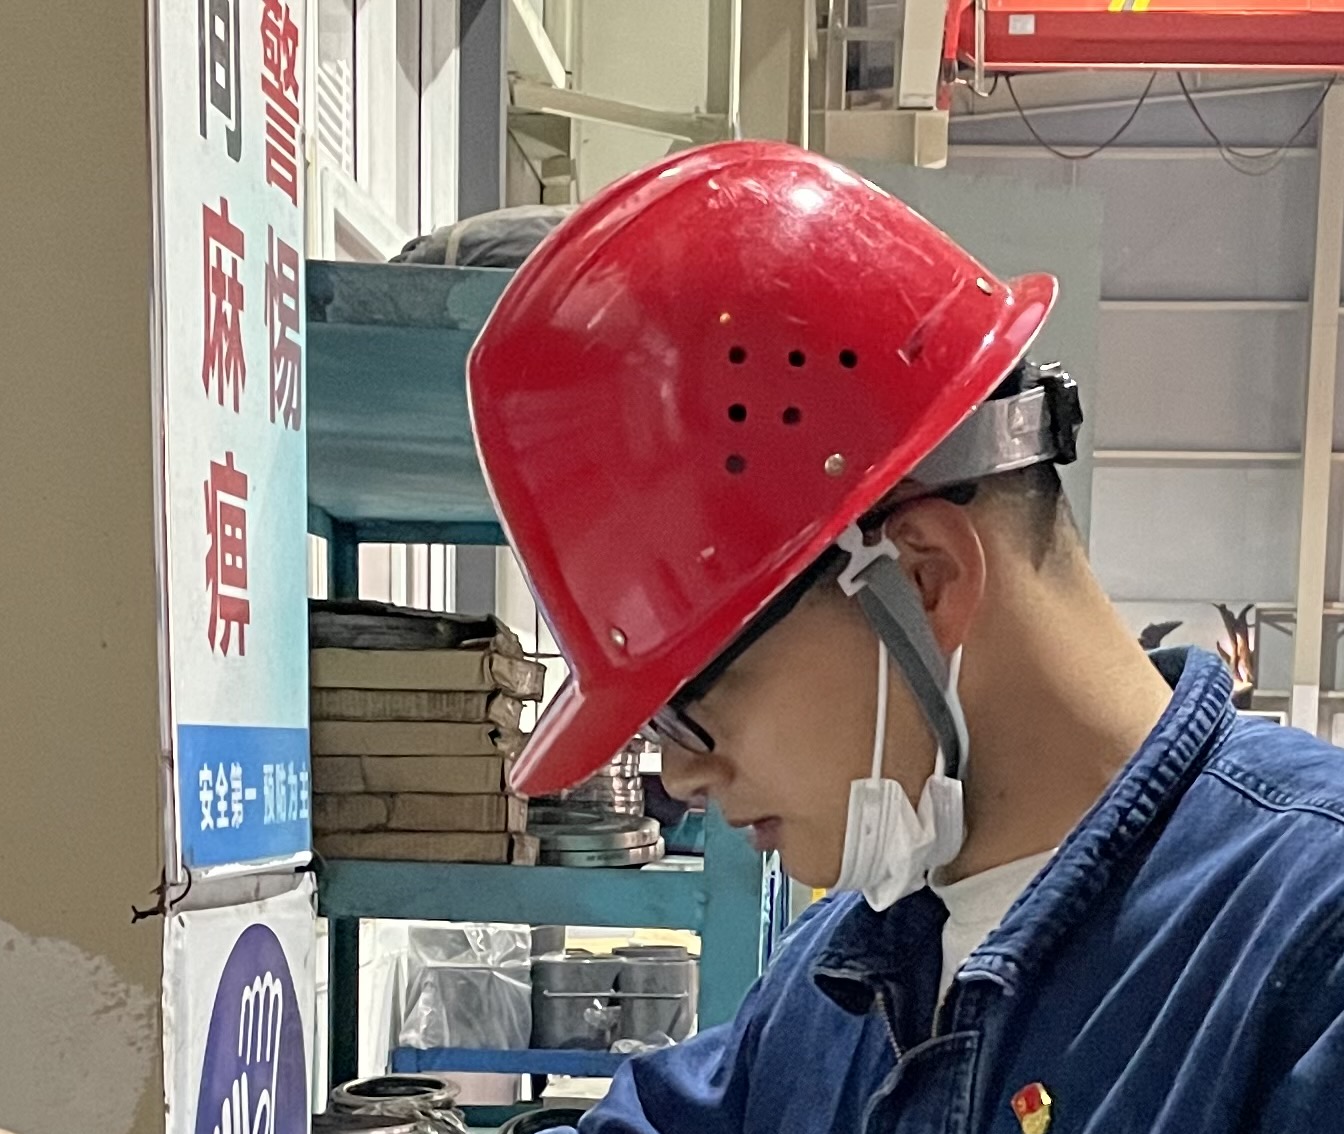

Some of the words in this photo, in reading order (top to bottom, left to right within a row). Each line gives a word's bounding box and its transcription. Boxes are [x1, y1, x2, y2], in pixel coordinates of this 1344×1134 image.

[199, 761, 257, 831] 安全第一
[262, 761, 309, 825] 预防为主
